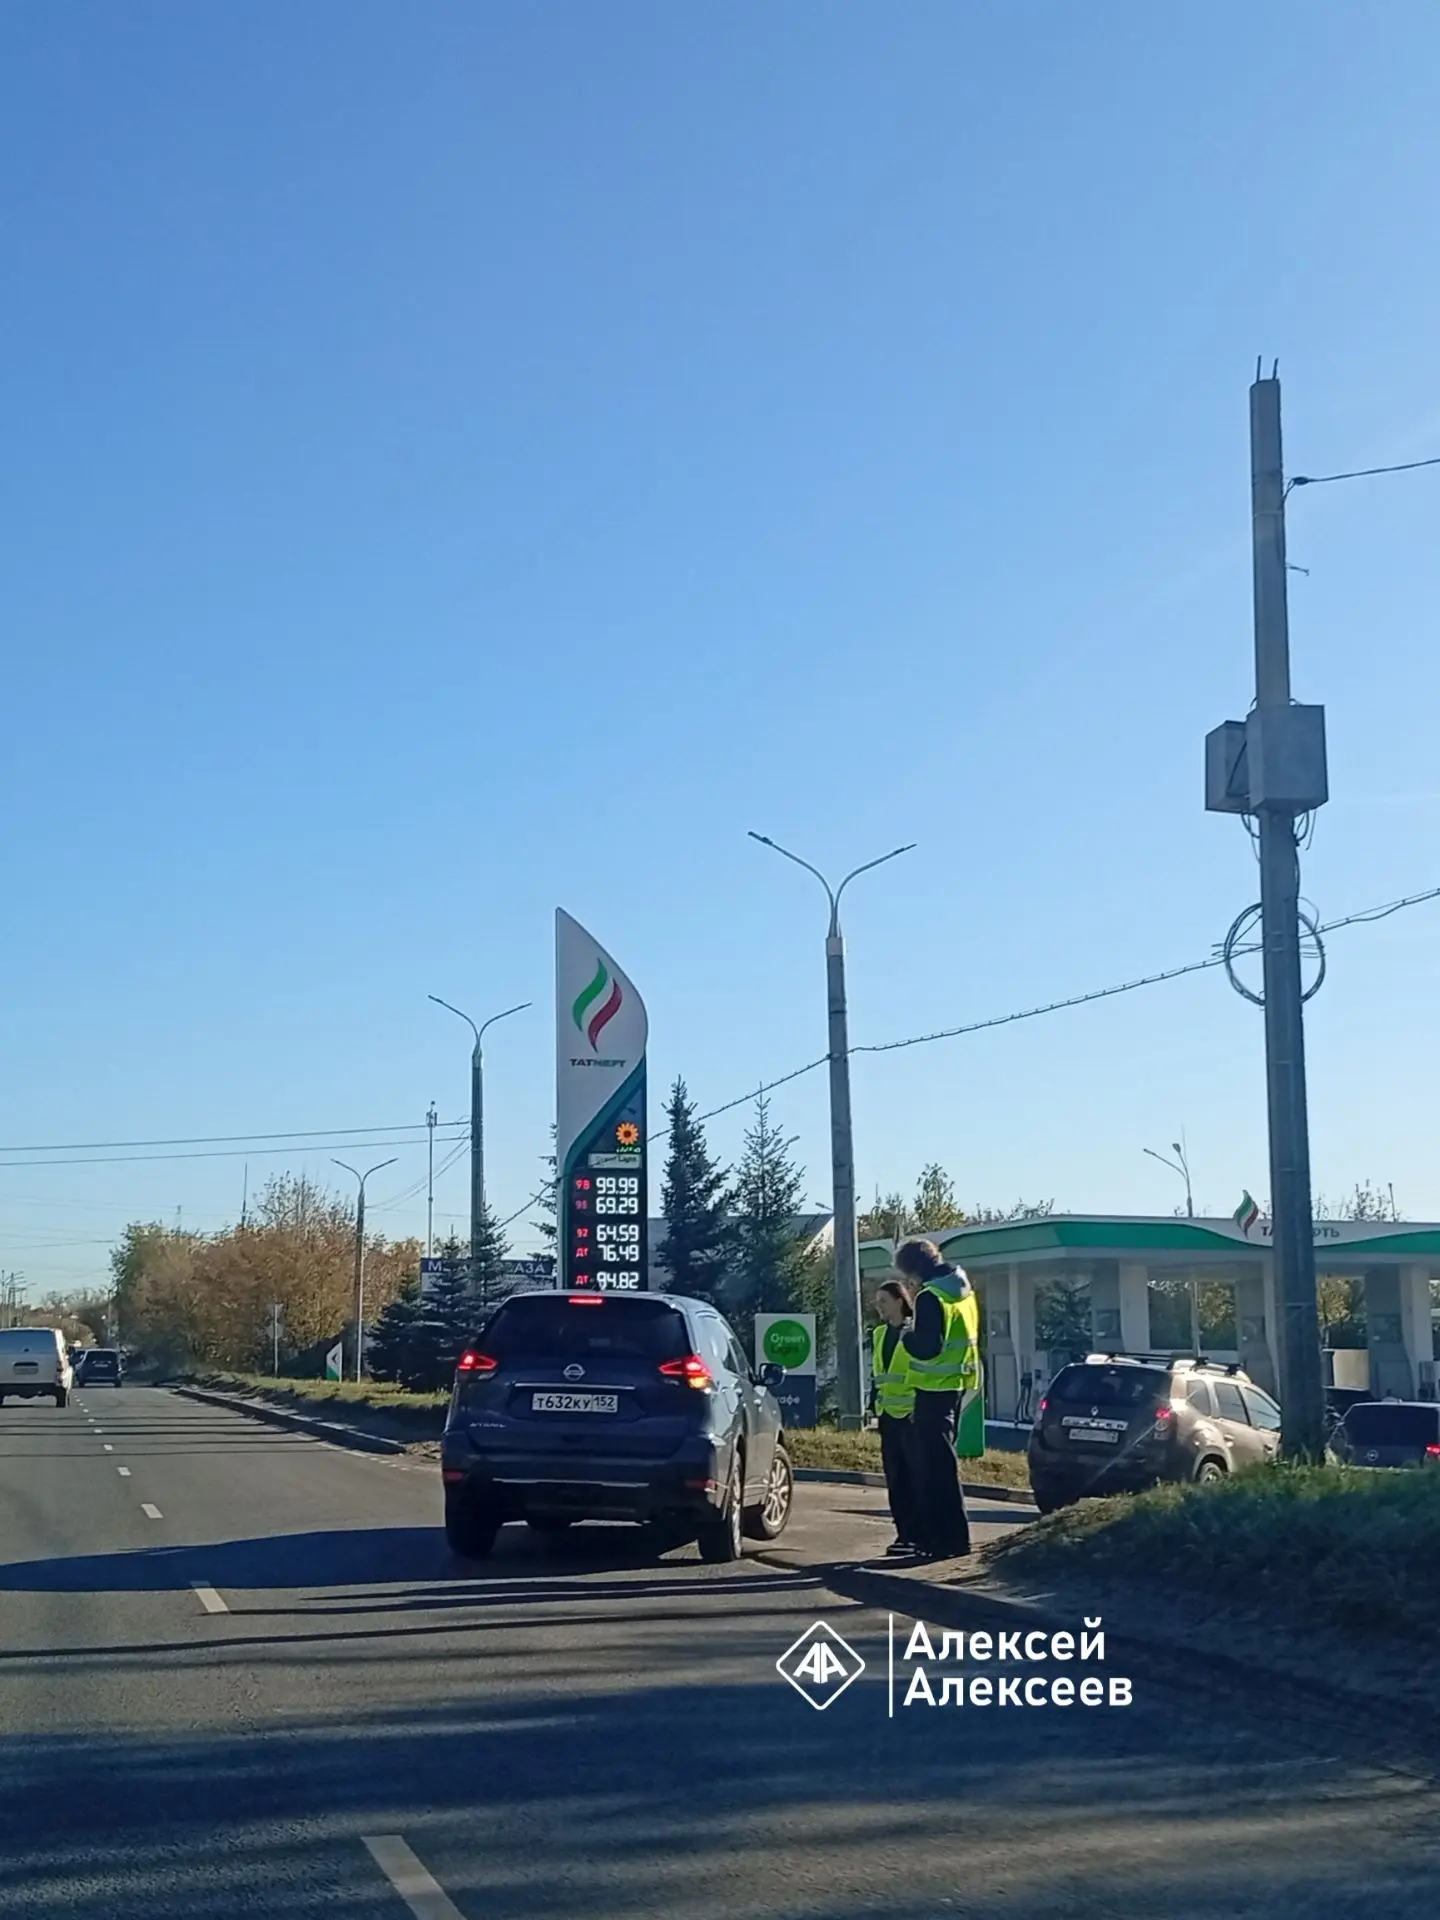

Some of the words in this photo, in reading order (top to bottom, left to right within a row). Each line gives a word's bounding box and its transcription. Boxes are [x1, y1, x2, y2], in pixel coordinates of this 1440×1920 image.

[575, 1180, 590, 1190] 98
[596, 1177, 638, 1194] 99.99
[596, 1197, 638, 1214] 69.29
[577, 1228, 588, 1238] 92
[596, 1224, 639, 1241] 64.59
[576, 1247, 588, 1257] ДТ
[598, 1244, 639, 1261] 76.49
[770, 1332, 805, 1347] Green
[777, 1394, 801, 1406] афе
